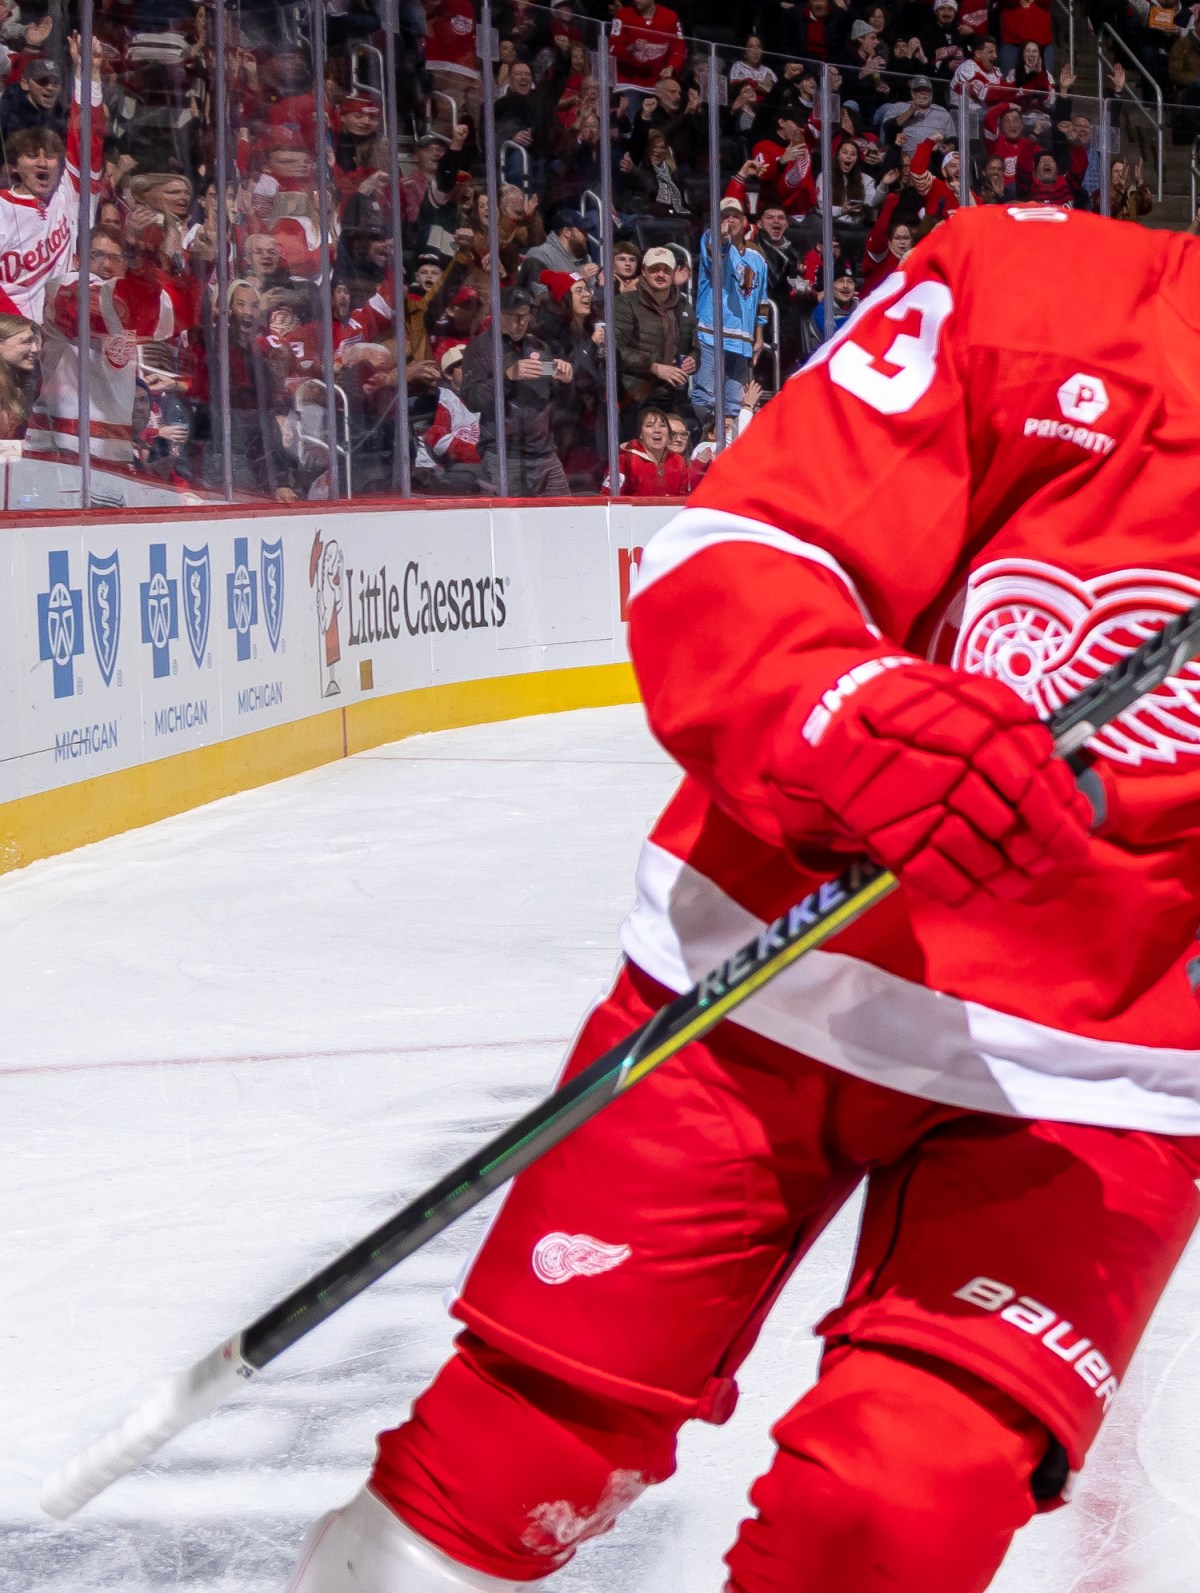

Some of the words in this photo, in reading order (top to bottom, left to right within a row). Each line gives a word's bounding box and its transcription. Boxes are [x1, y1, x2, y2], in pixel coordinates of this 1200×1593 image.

[790, 271, 955, 415] 3
[1023, 417, 1117, 455] PRIORITY
[346, 565, 401, 647] Little
[403, 561, 507, 637] Caesars
[154, 699, 208, 736] MICHIGAN
[237, 681, 283, 714] MICHIGAN
[54, 720, 118, 763] MICHIGAN
